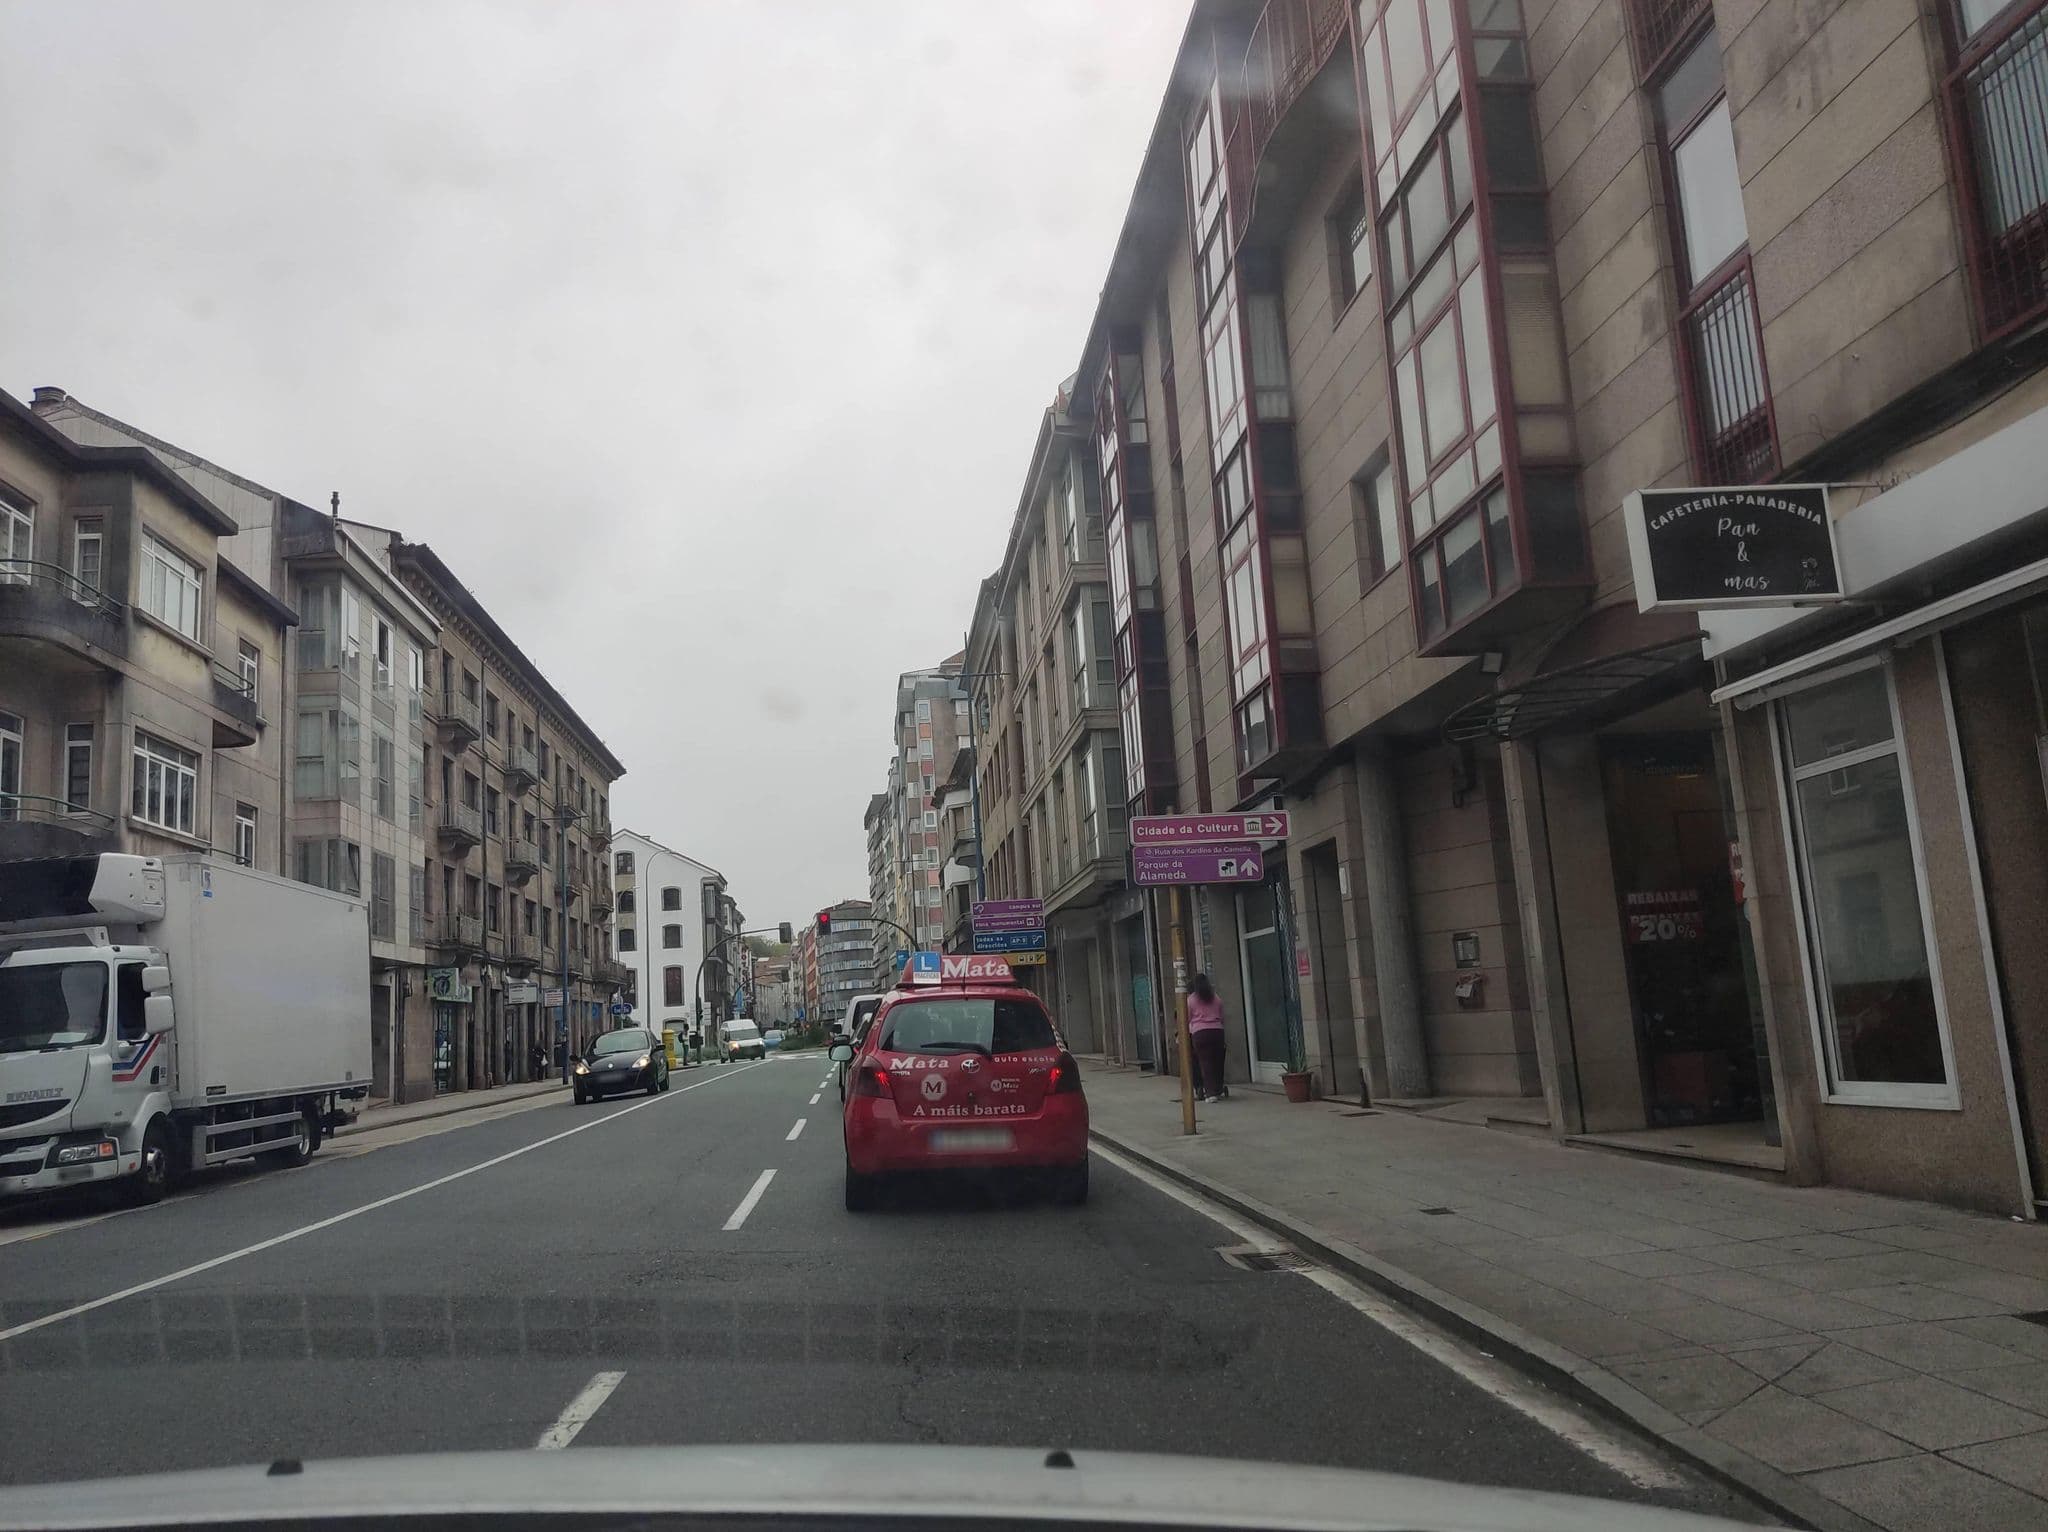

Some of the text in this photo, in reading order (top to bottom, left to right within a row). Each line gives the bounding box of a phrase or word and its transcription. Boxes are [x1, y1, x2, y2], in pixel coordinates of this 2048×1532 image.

[1717, 517, 1760, 537] Pan
[1737, 540, 1750, 562] &
[1724, 575, 1770, 591] mas
[1136, 822, 1239, 836] Cidade da Cultura
[1138, 859, 1183, 871] Parque da
[1139, 869, 1187, 880] Alameda
[920, 956, 932, 971] L
[942, 958, 1009, 979] Mata
[889, 1056, 949, 1070] Mata
[6, 1087, 64, 1101] RENAULT
[925, 1081, 942, 1094] M
[913, 1102, 1026, 1117] A máis barata
